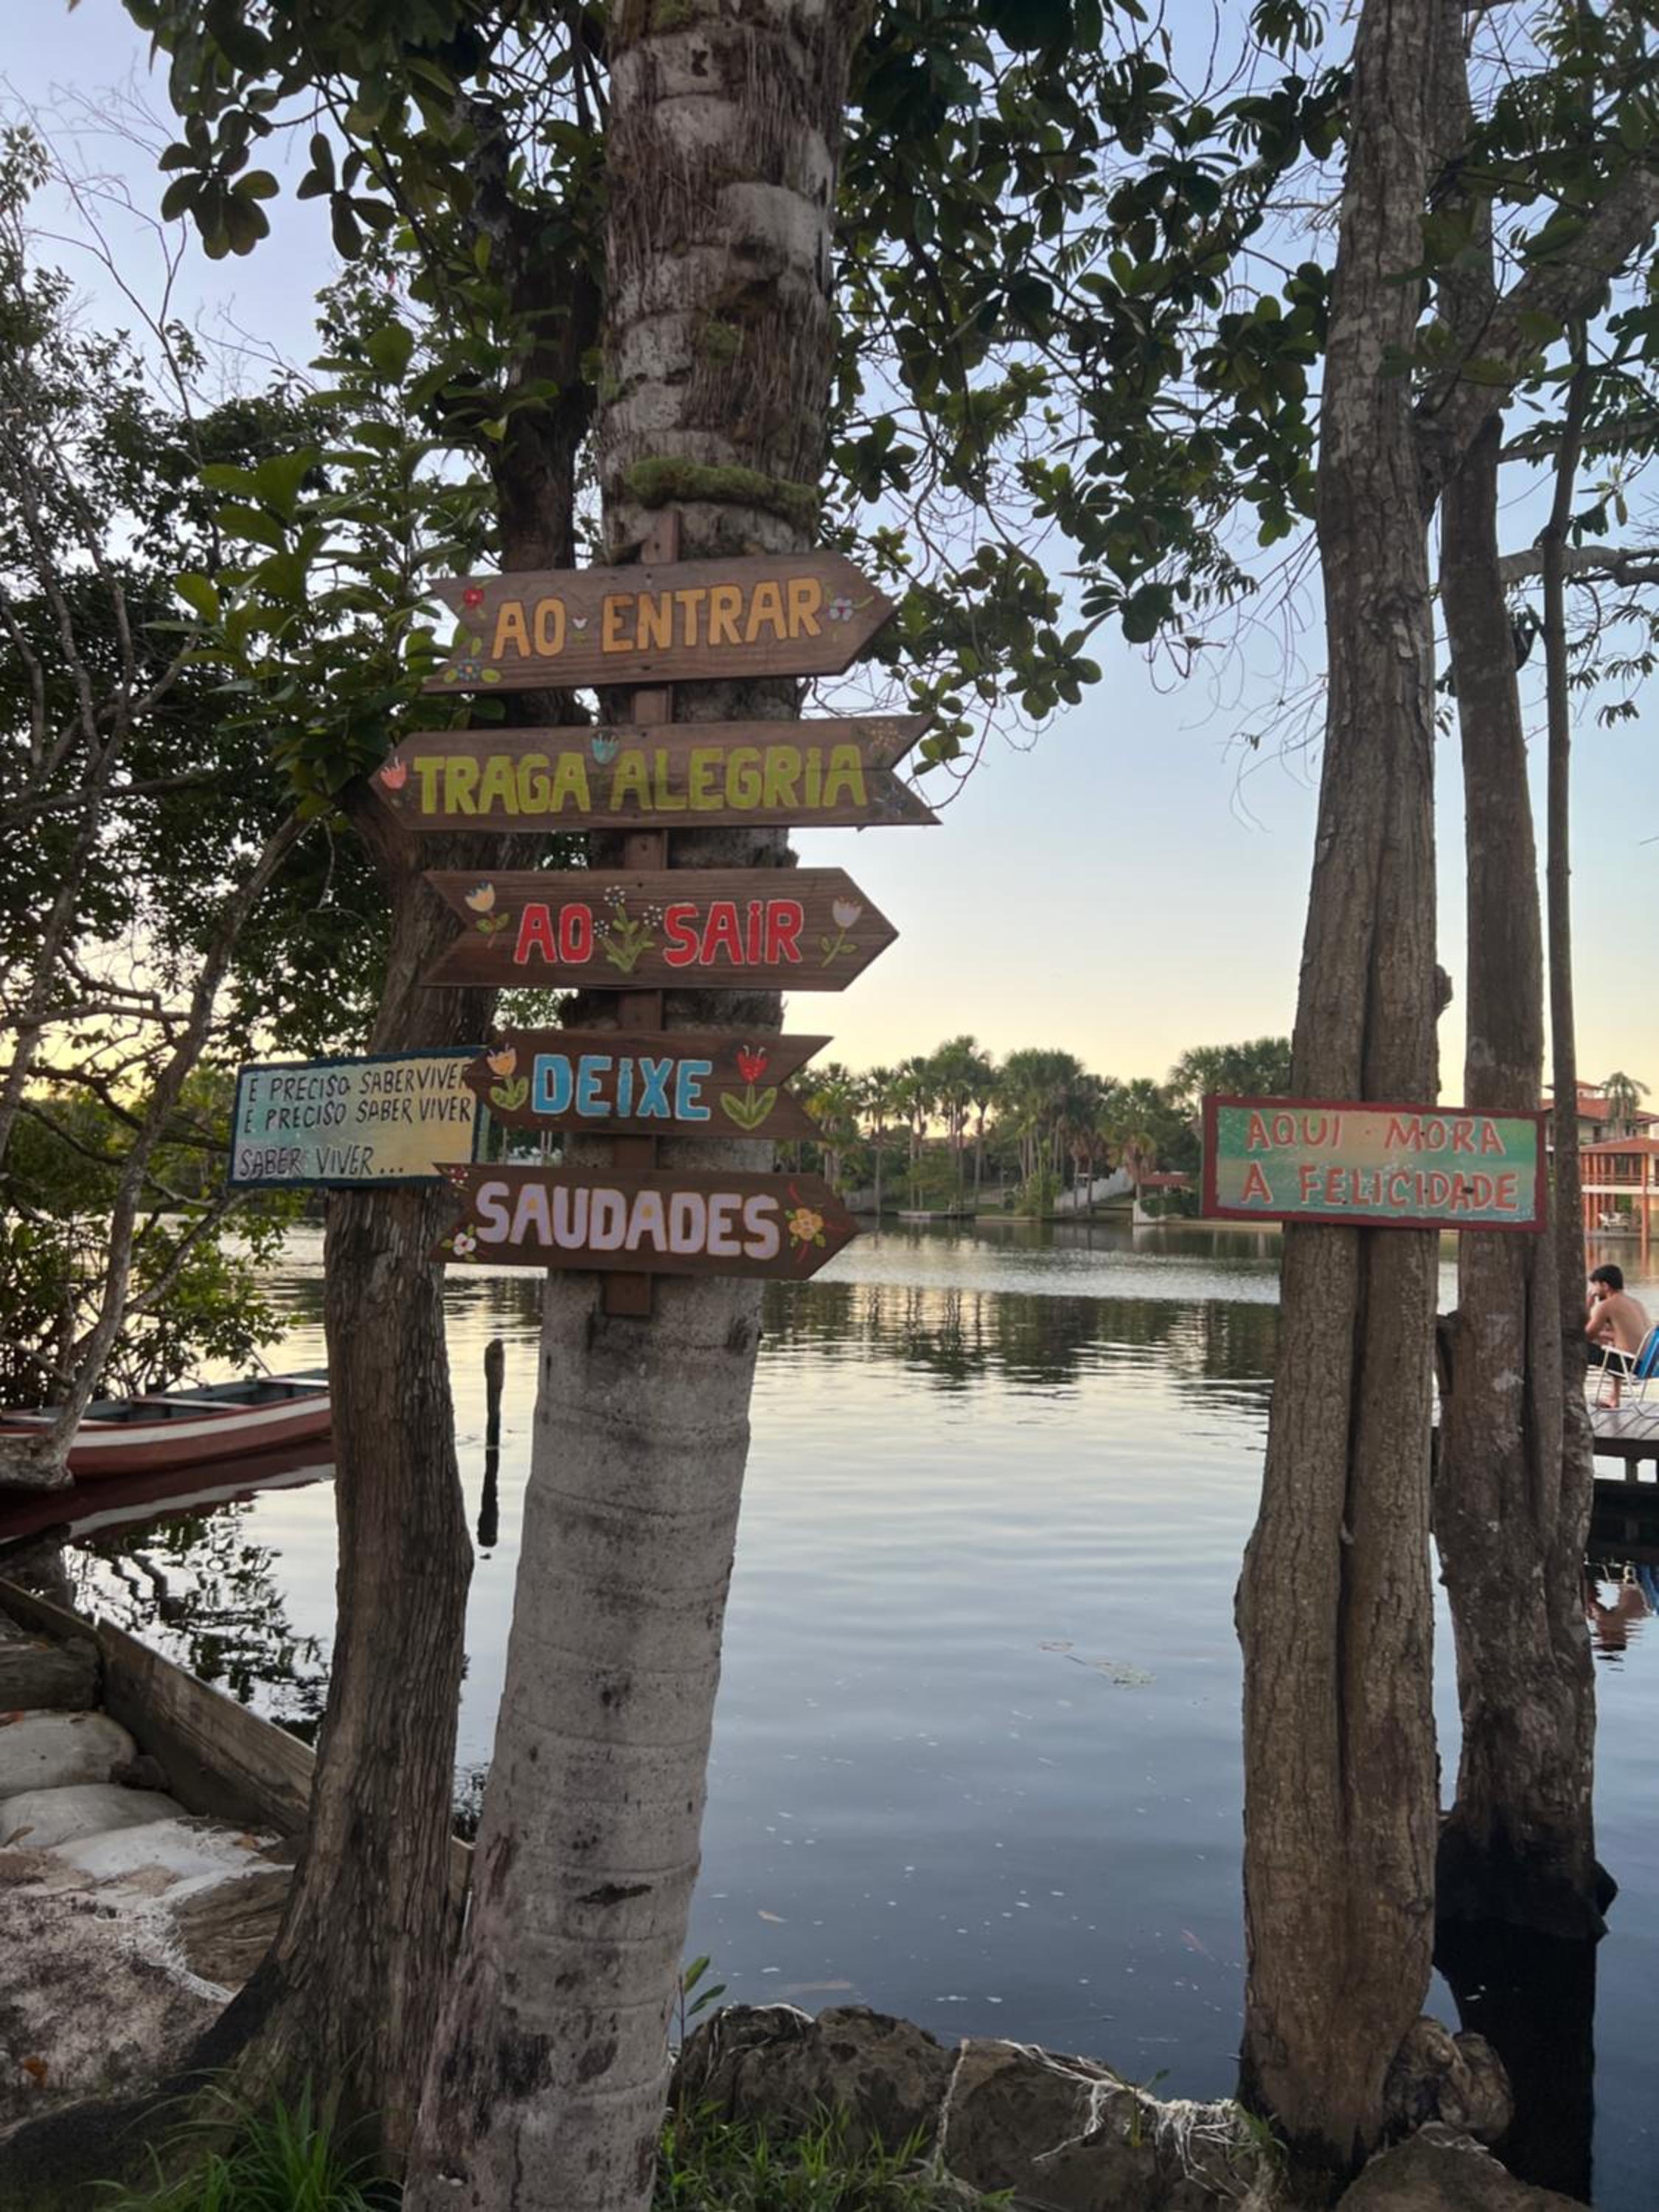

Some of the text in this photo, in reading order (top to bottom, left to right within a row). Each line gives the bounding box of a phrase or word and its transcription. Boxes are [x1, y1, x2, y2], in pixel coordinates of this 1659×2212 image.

[491, 576, 824, 661] AO ENTRAR
[413, 752, 590, 815] TRAGA
[513, 902, 594, 964] AO
[265, 1100, 347, 1131] PRECISO
[355, 1097, 413, 1124] SABER
[420, 1096, 471, 1121] VIVER
[269, 1074, 350, 1102] PRECISO
[1246, 1109, 1506, 1156] AQUI MORA
[240, 1147, 303, 1178] SABER
[1240, 1161, 1519, 1212] A FELICIDADE
[474, 1180, 780, 1260] SAUDADES
